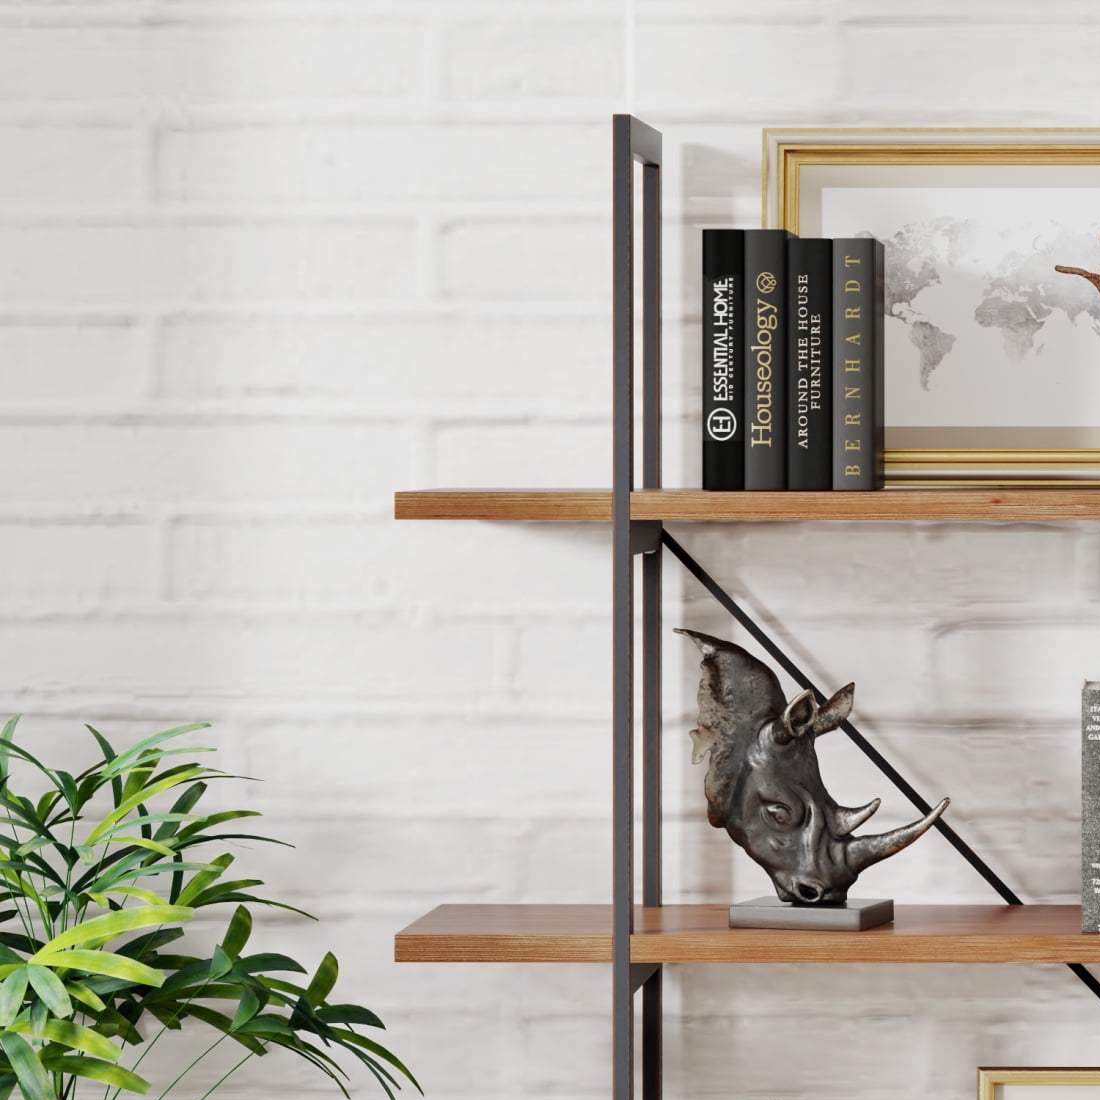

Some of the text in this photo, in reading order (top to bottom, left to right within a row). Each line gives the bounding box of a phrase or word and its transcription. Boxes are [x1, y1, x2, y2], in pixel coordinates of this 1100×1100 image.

[713, 278, 729, 401] ESSENTIAL HOME
[751, 298, 777, 448] Houseology
[797, 274, 809, 449] AROUND THE HOUSE
[810, 314, 821, 410] FURNITURE
[845, 255, 861, 476] BERNHARDT
